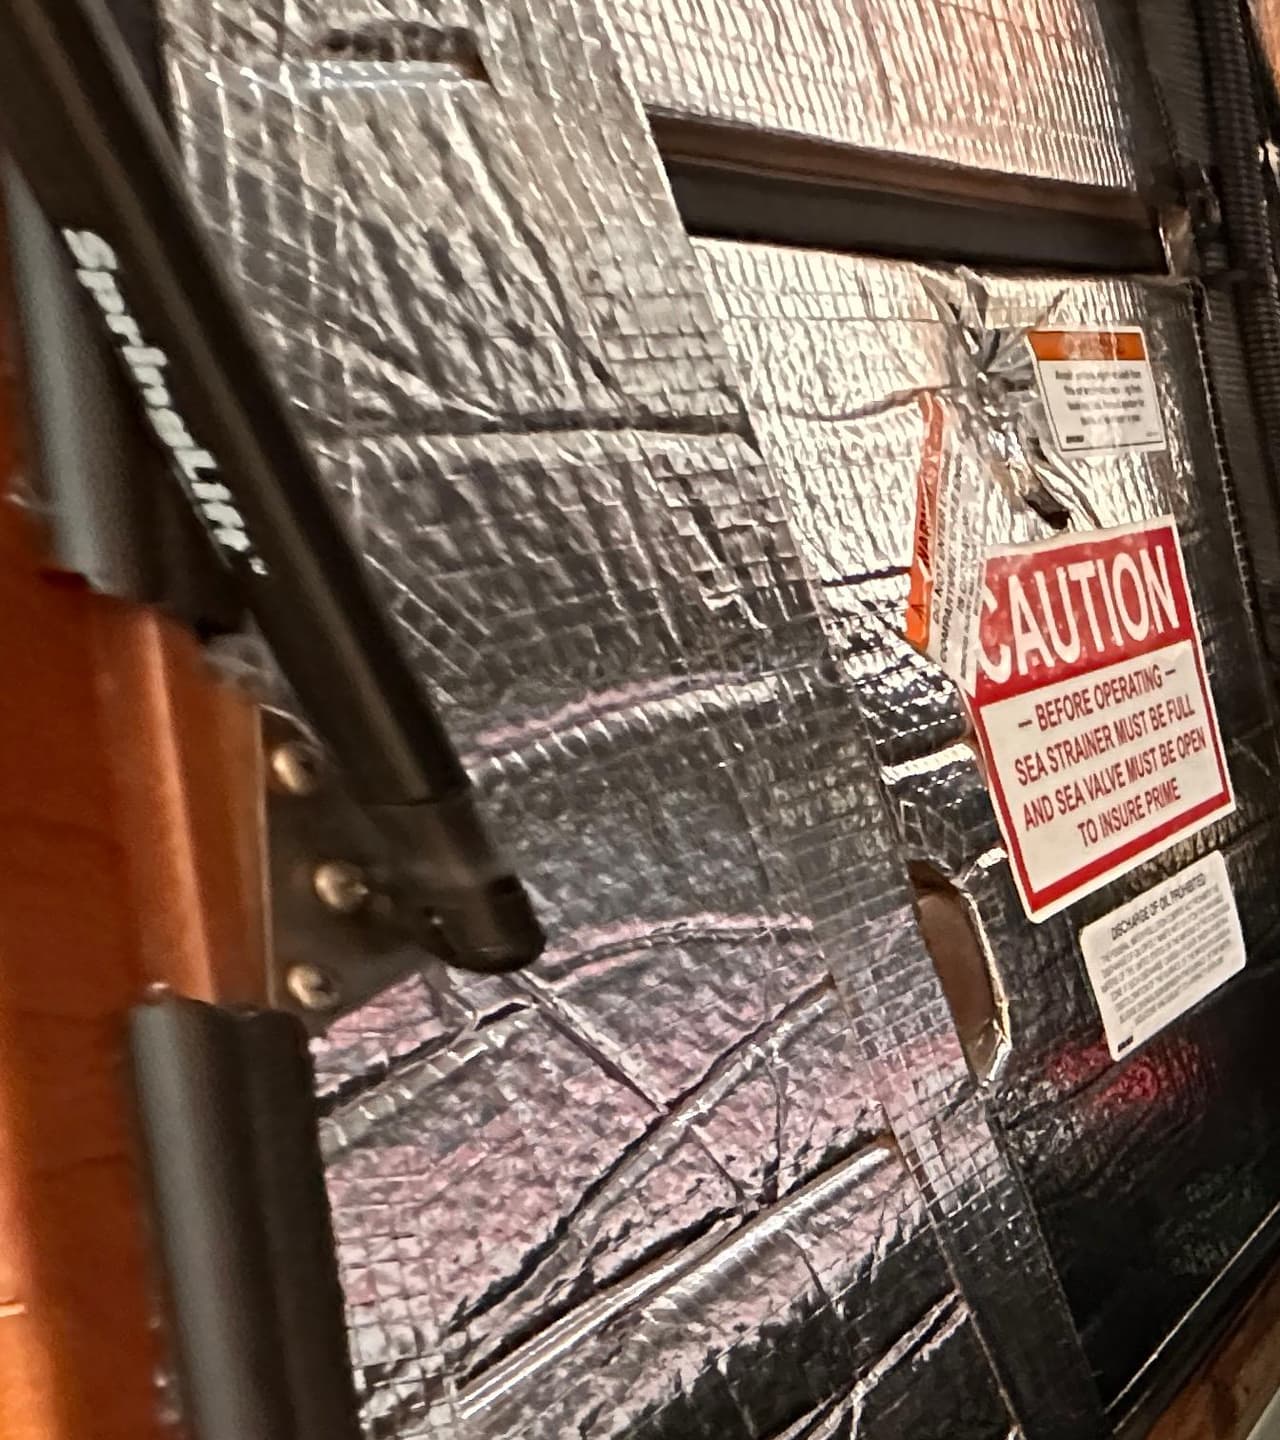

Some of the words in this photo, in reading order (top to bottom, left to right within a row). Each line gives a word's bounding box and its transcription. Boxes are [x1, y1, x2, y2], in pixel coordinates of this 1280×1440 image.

[974, 545, 1180, 686] CAUTION
[1015, 752, 1048, 786] SEA
[1050, 725, 1114, 775] STRAINER
[1116, 709, 1155, 744] MUST
[1150, 704, 1169, 731] BE
[1168, 693, 1196, 727] FULL
[1035, 688, 1093, 732] BEFORE
[1093, 664, 1163, 713] OPERATING
[1023, 798, 1055, 832] AND
[1056, 788, 1084, 819] SEA
[1083, 766, 1126, 806] VALVE
[1127, 752, 1160, 786] MUST
[1159, 744, 1177, 770] BE
[1178, 725, 1208, 760] OPEN
[1077, 821, 1098, 848] TO
[1099, 795, 1146, 838] INSURE
[1144, 776, 1181, 813] PRIME
